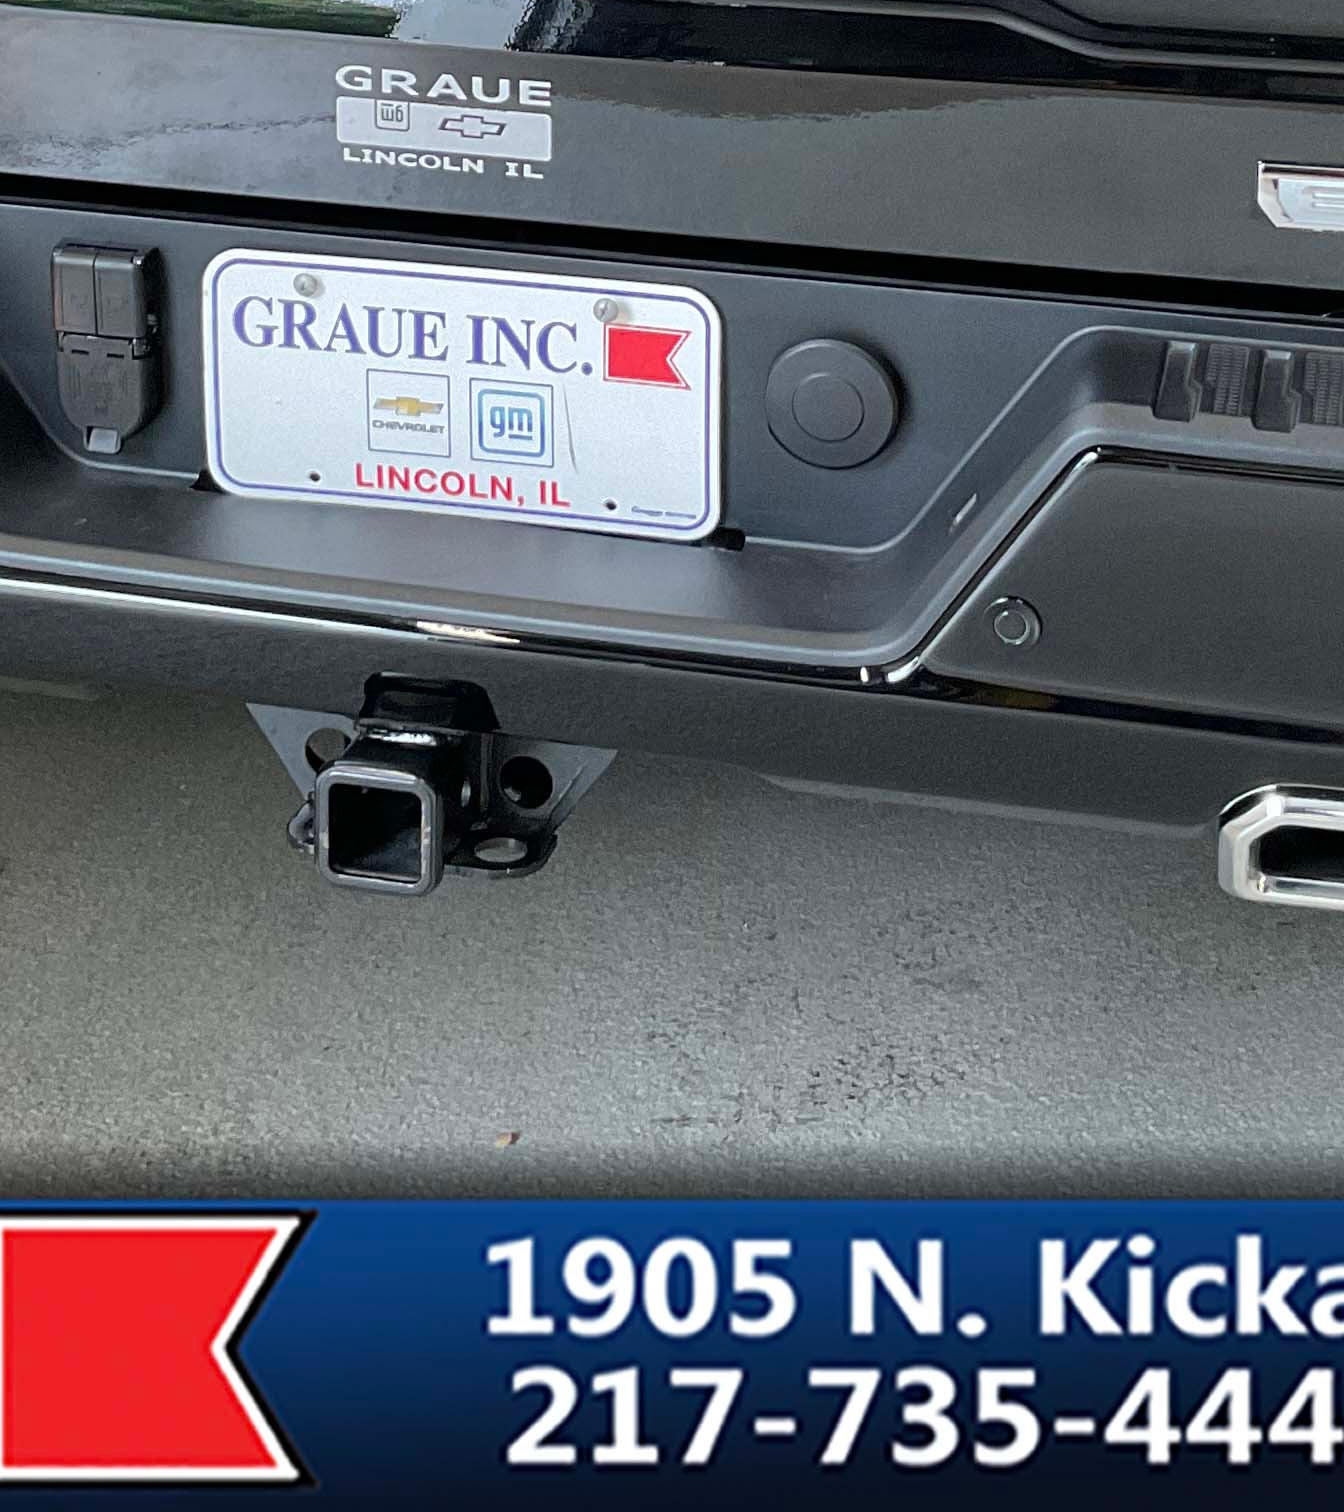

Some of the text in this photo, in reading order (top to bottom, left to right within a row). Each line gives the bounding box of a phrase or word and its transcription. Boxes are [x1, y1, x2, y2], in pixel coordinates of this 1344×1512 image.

[335, 65, 552, 107] GRAUE
[343, 148, 544, 179] LINCOLN IL
[232, 295, 593, 375] GRAUE INC.
[372, 419, 445, 434] CHEVROLET
[490, 406, 533, 440] gm
[355, 463, 570, 507] LINCOLN, IL
